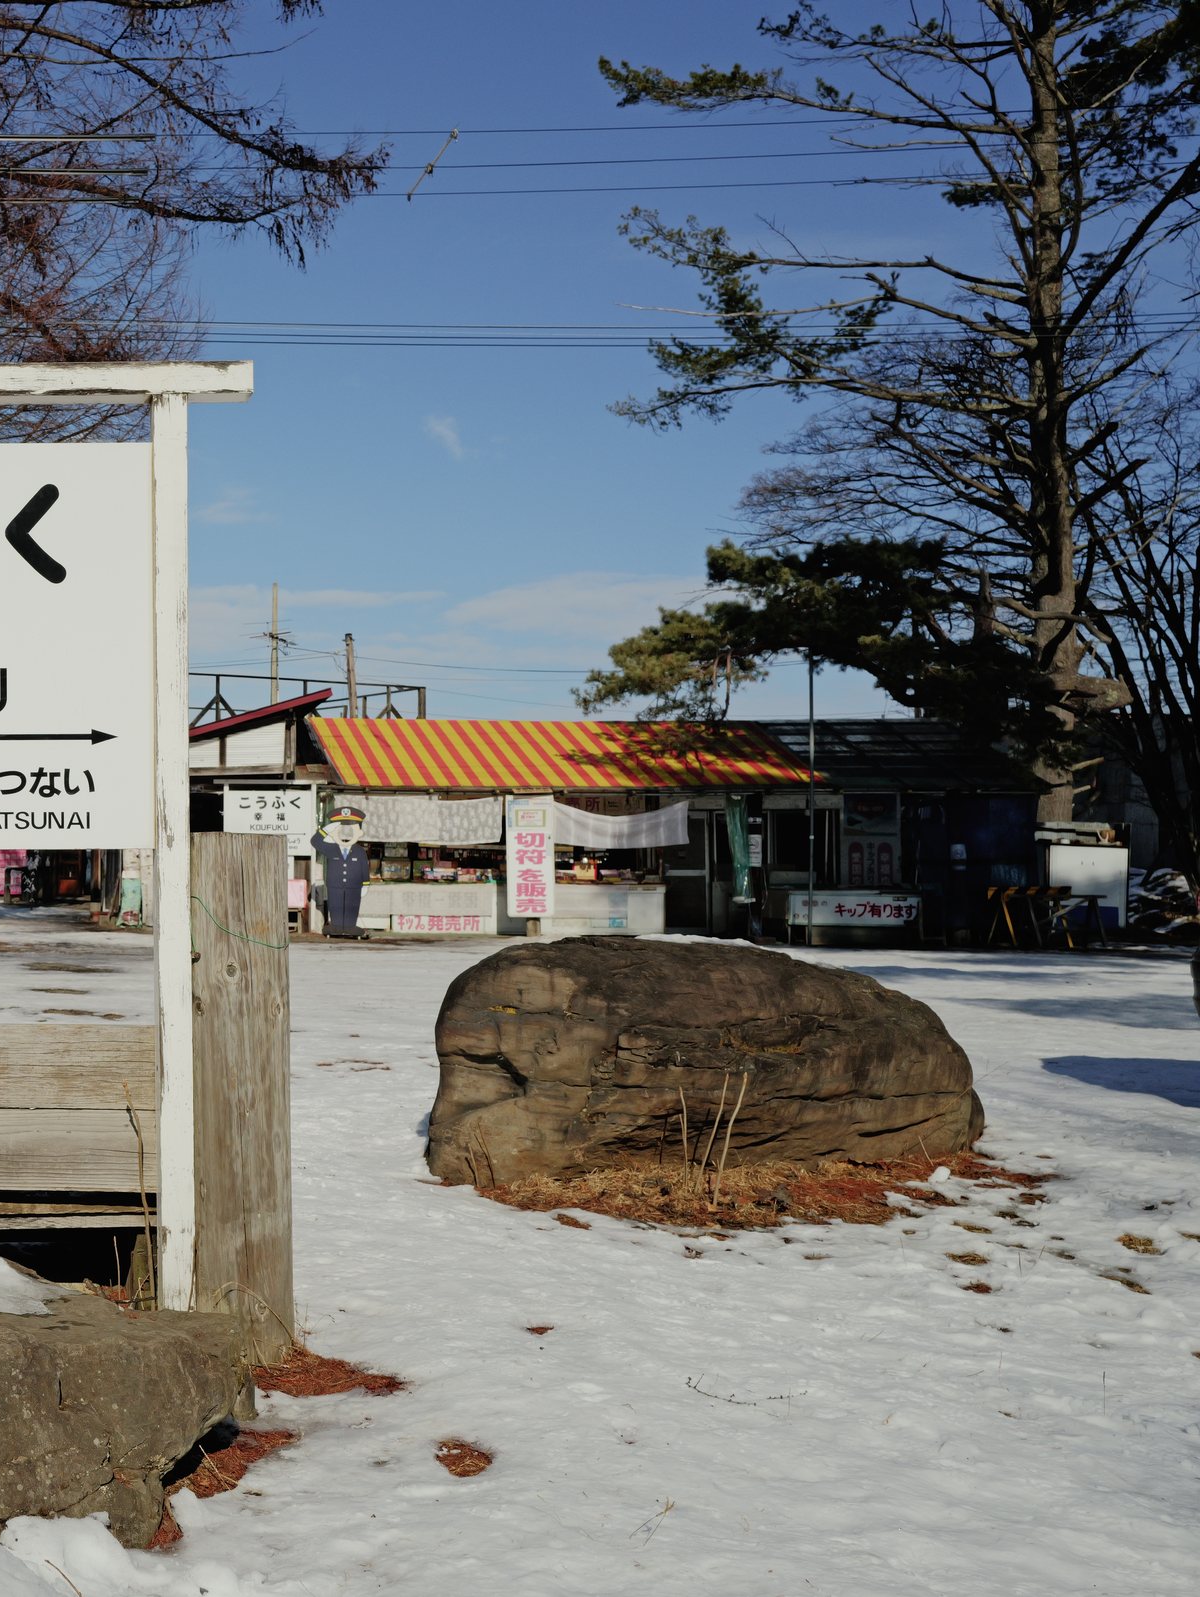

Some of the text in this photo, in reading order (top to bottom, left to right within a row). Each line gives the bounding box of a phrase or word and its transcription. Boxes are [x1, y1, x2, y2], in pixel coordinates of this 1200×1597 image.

[239, 796, 301, 809] こうふく
[254, 812, 286, 821] 幸福
[514, 832, 547, 914] 切符を販売
